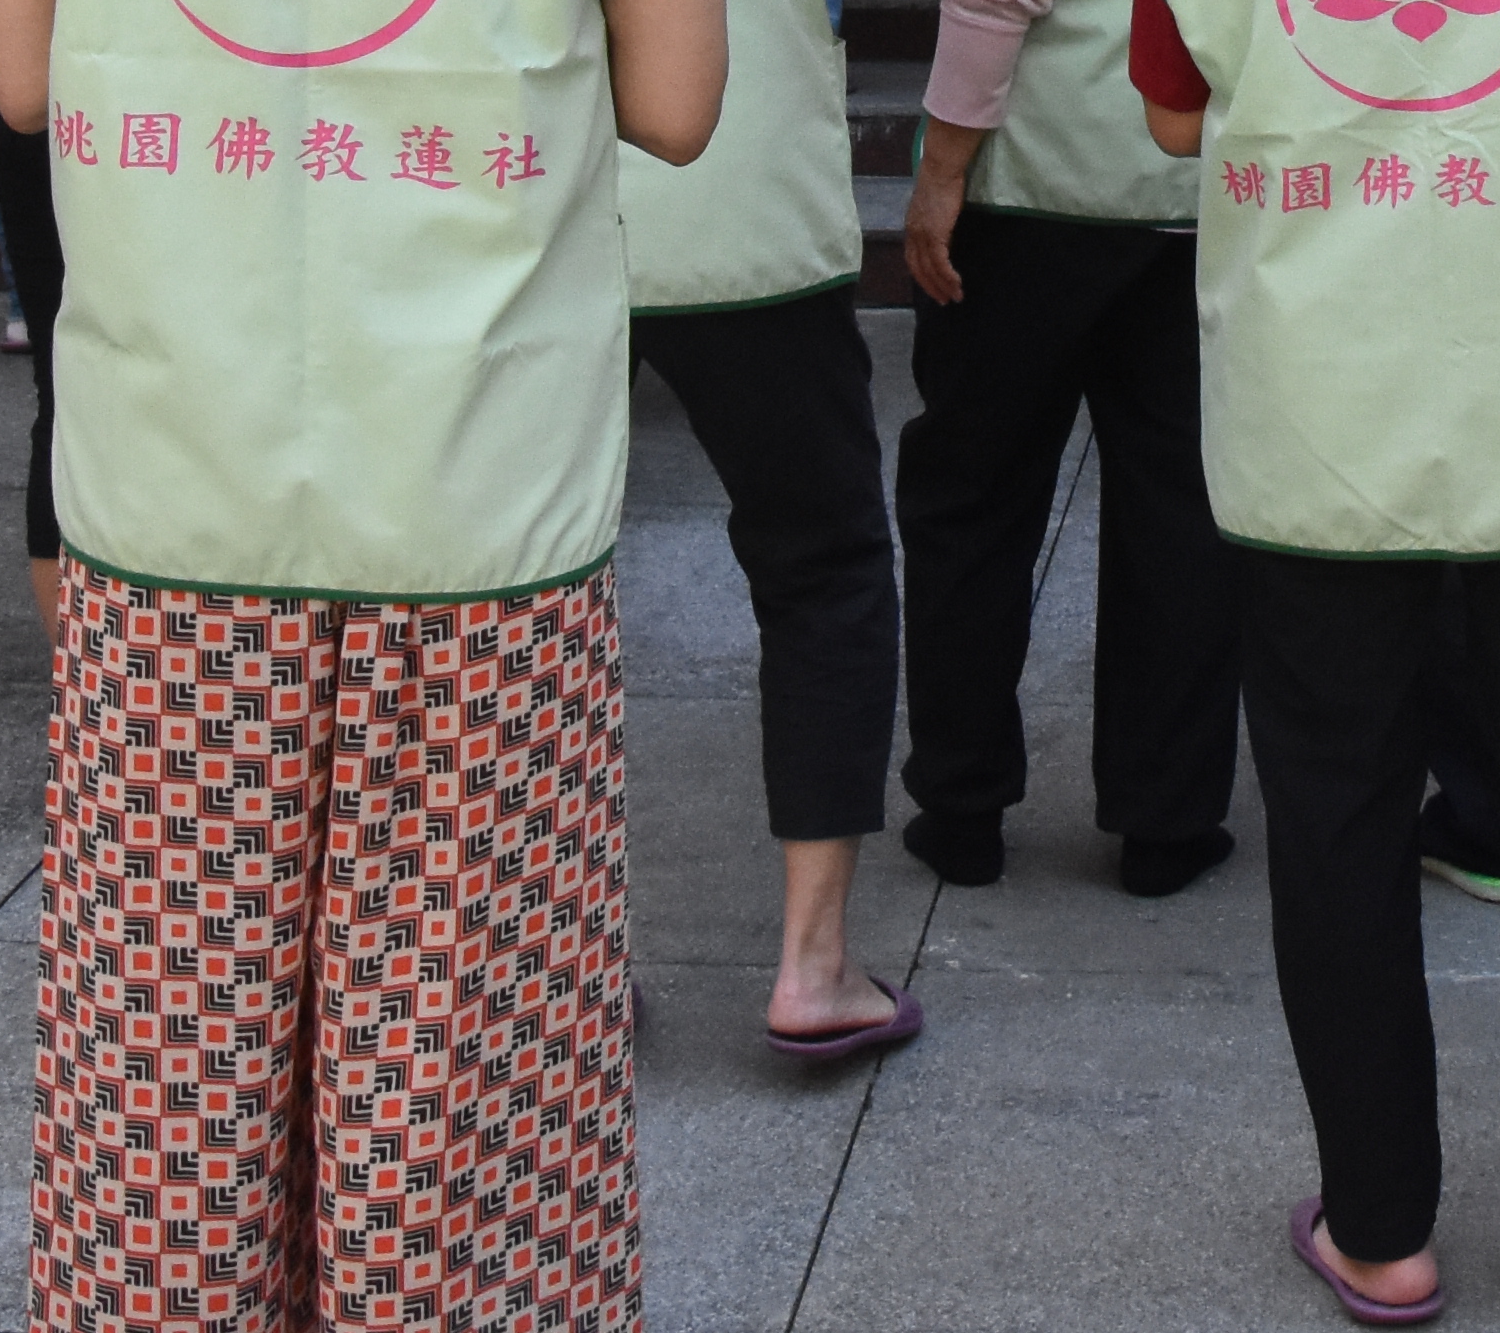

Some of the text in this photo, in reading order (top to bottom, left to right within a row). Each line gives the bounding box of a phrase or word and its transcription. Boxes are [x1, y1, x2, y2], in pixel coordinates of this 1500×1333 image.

[52, 100, 547, 191] 桃園佛教蓮社
